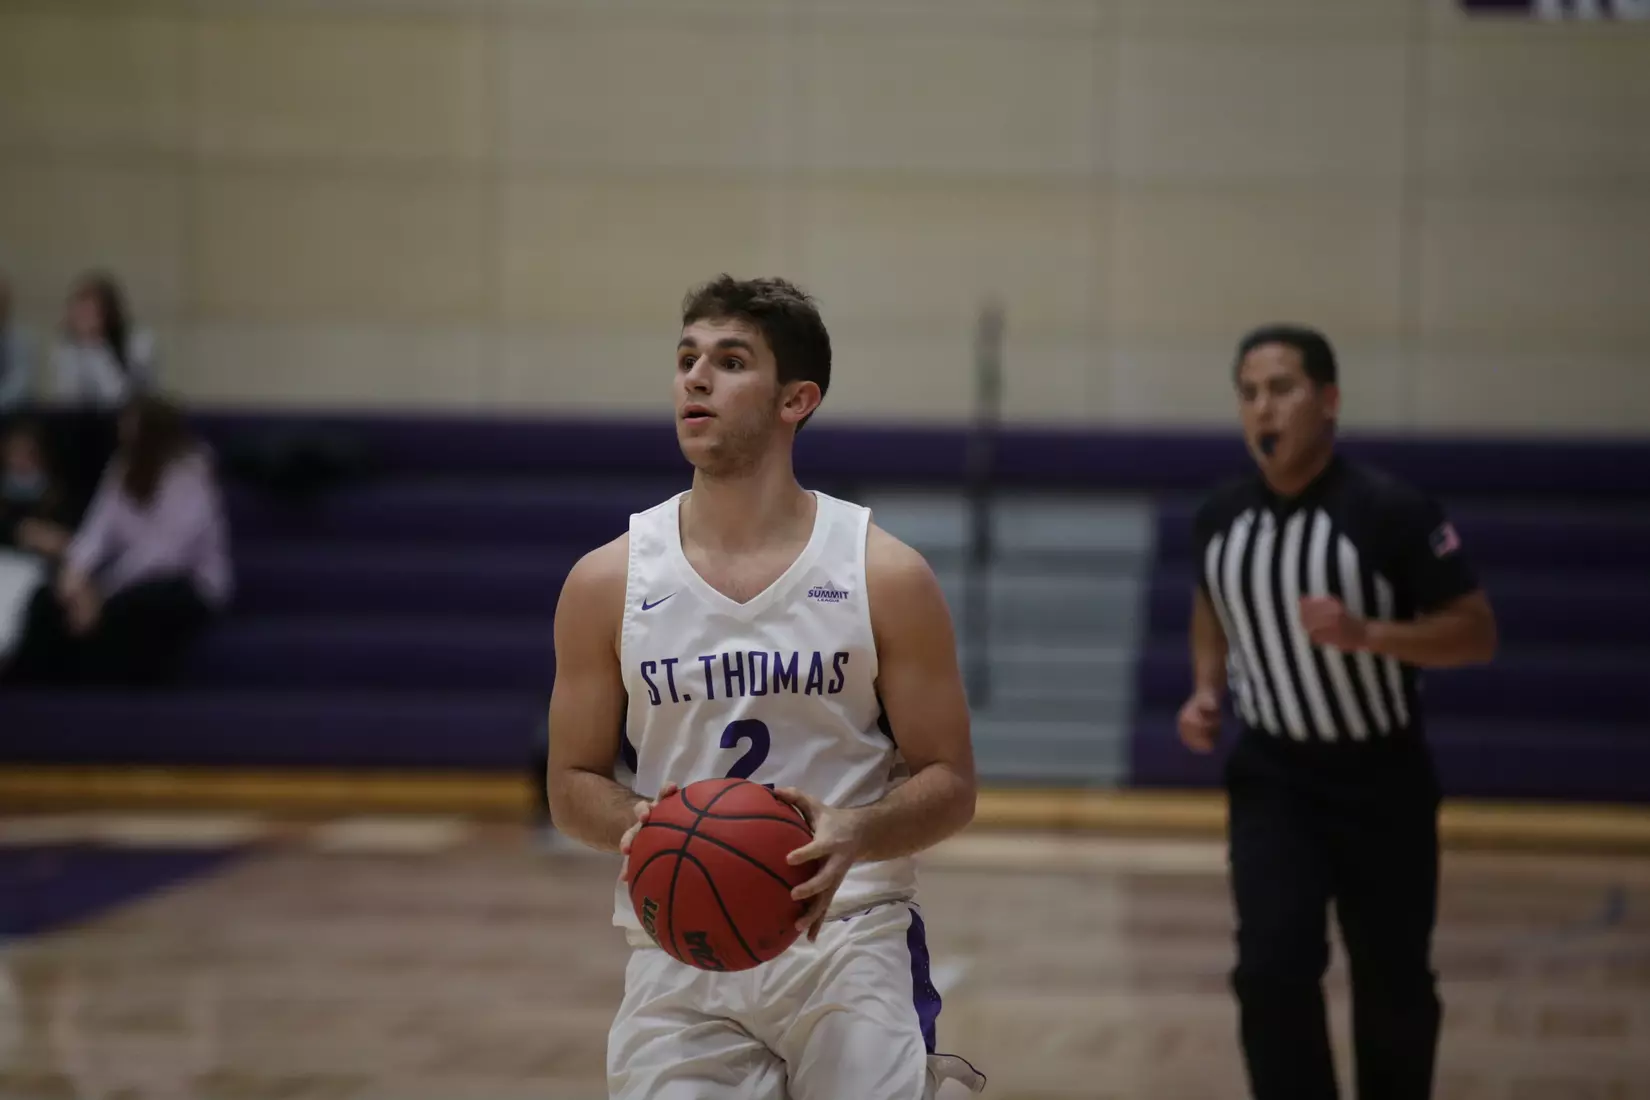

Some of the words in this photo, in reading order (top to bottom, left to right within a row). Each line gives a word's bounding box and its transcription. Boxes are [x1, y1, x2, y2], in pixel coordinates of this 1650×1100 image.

[807, 589, 849, 600] SUMMIT
[640, 657, 692, 706] ST.
[698, 650, 850, 700] THOMAS
[719, 718, 775, 790] 2
